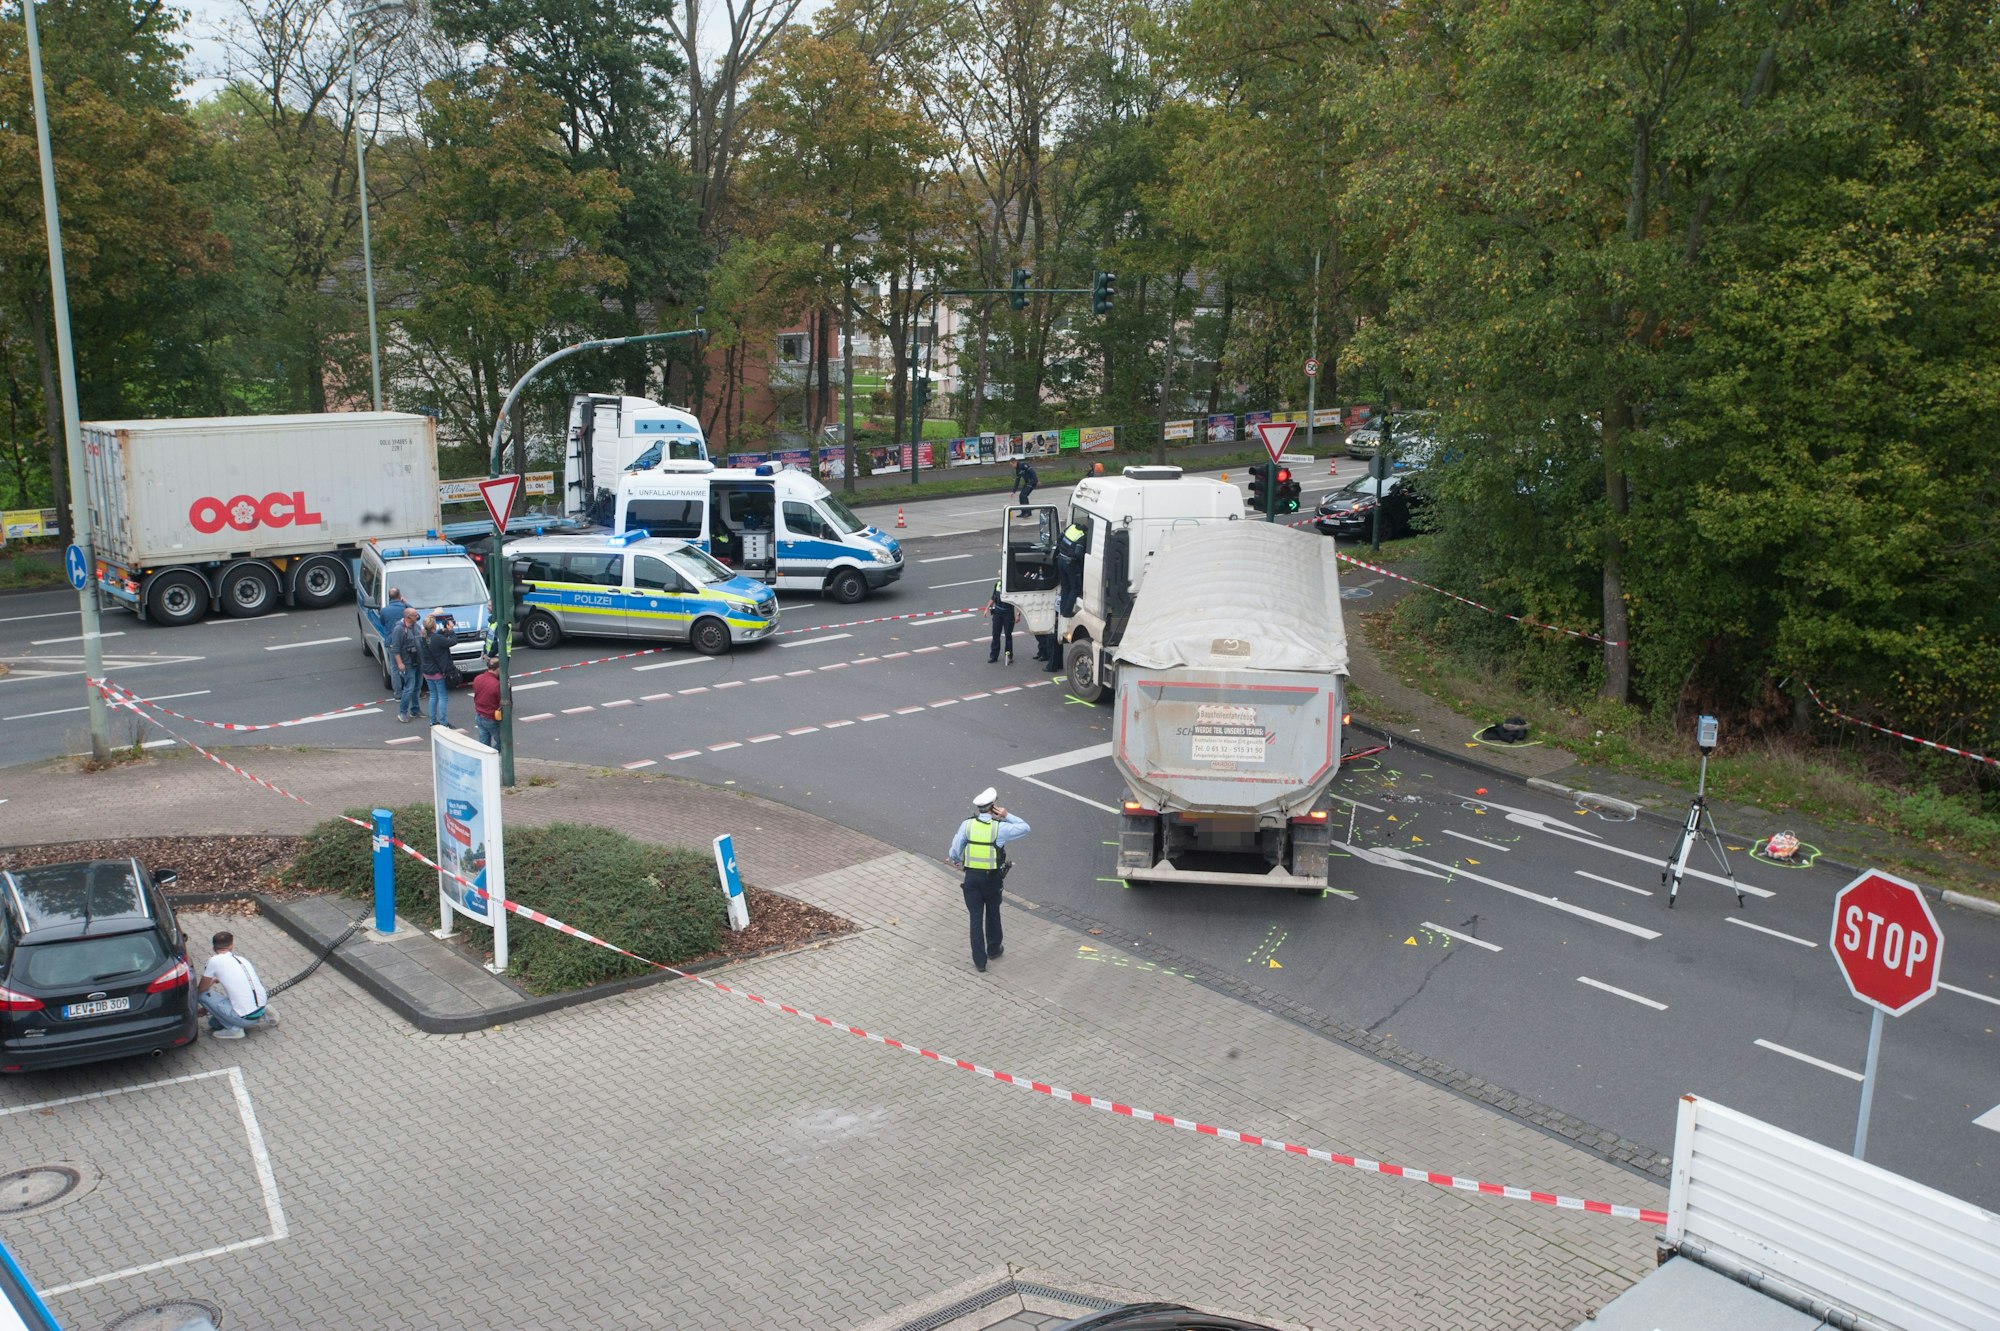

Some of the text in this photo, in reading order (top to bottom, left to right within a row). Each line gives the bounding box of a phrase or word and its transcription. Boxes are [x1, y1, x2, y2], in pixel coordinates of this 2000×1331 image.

[638, 489, 707, 497] UNFALLAUFNAHME
[189, 491, 322, 535] OOCL
[574, 594, 612, 606] POLIZEI
[1194, 726, 1213, 734] WERDE
[1223, 727, 1246, 735] UNSERES
[1843, 905, 1928, 978] STOP
[69, 998, 128, 1016] LEV DB 309
